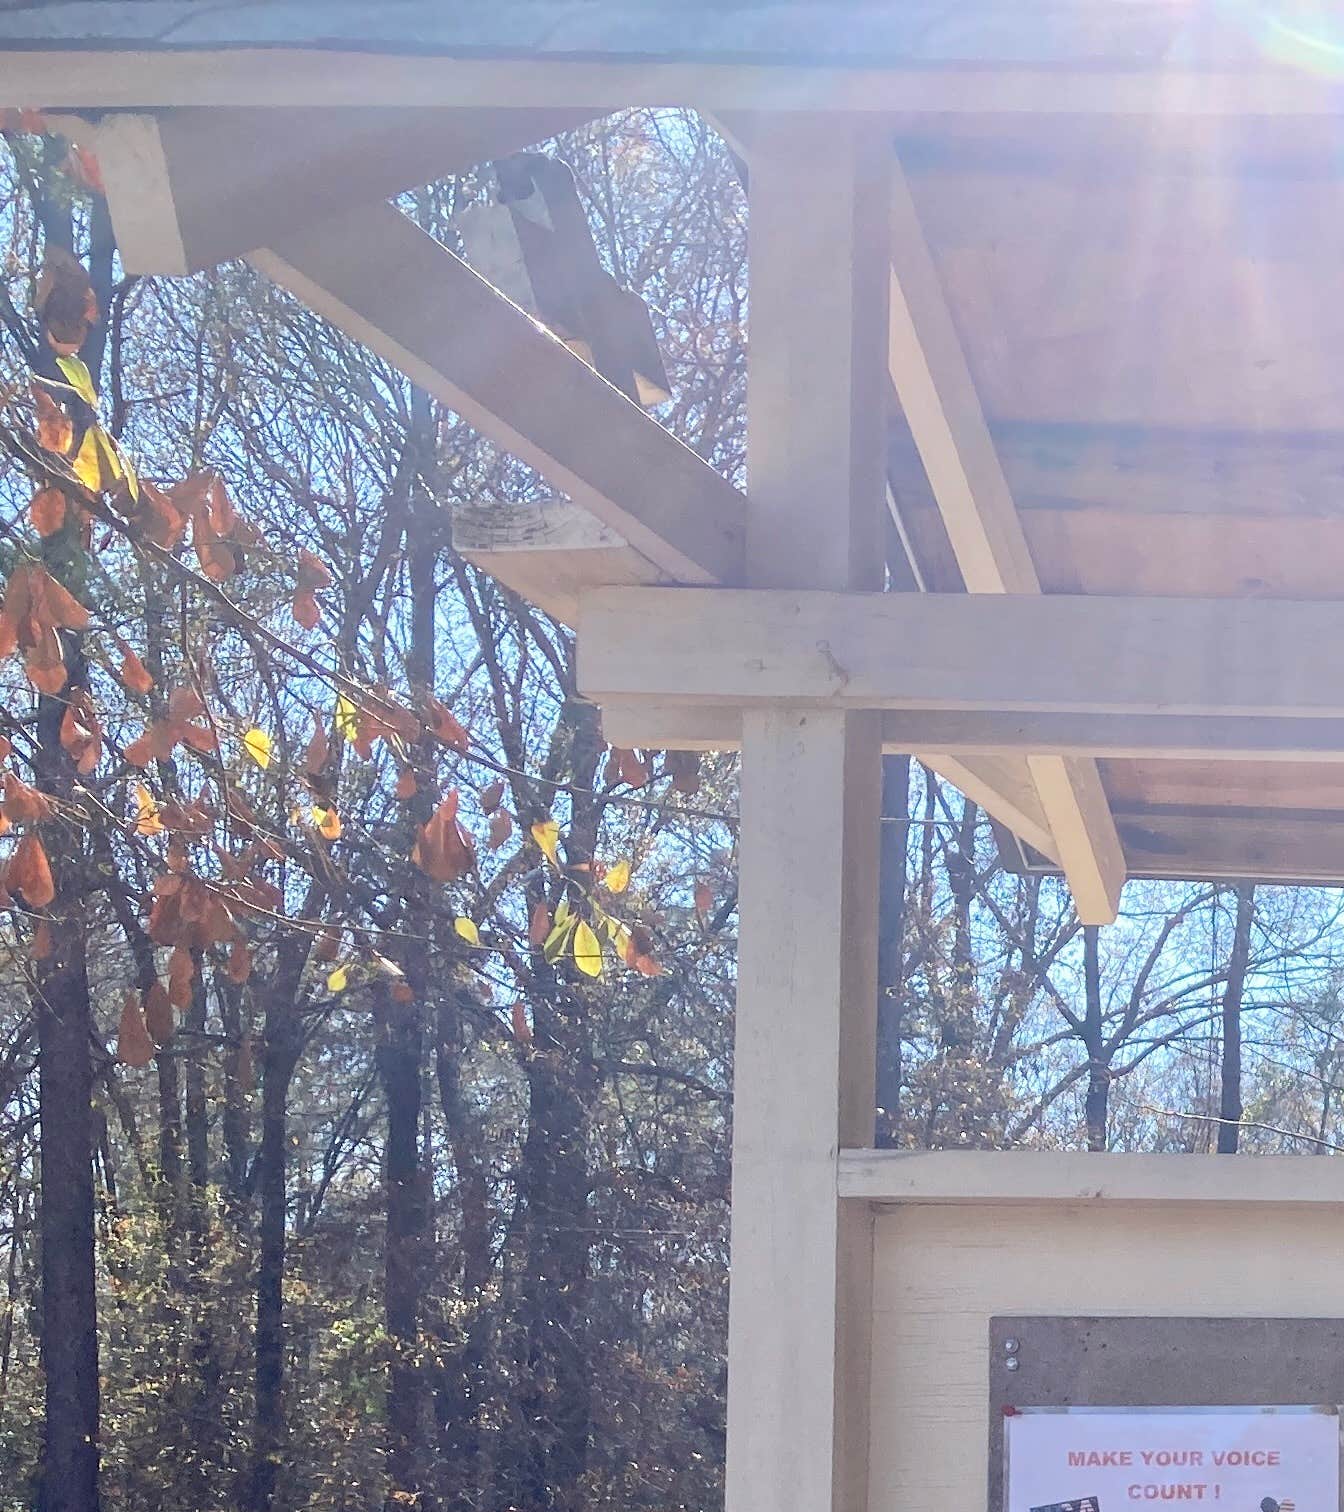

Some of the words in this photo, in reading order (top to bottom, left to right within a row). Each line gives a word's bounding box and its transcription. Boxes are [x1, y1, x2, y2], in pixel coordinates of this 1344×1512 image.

[1068, 1451, 1132, 1466] MAKE
[1140, 1450, 1203, 1466] YOUR
[1213, 1451, 1280, 1466] VOICE
[1128, 1484, 1207, 1500] COUNT
[1215, 1484, 1221, 1499] !
